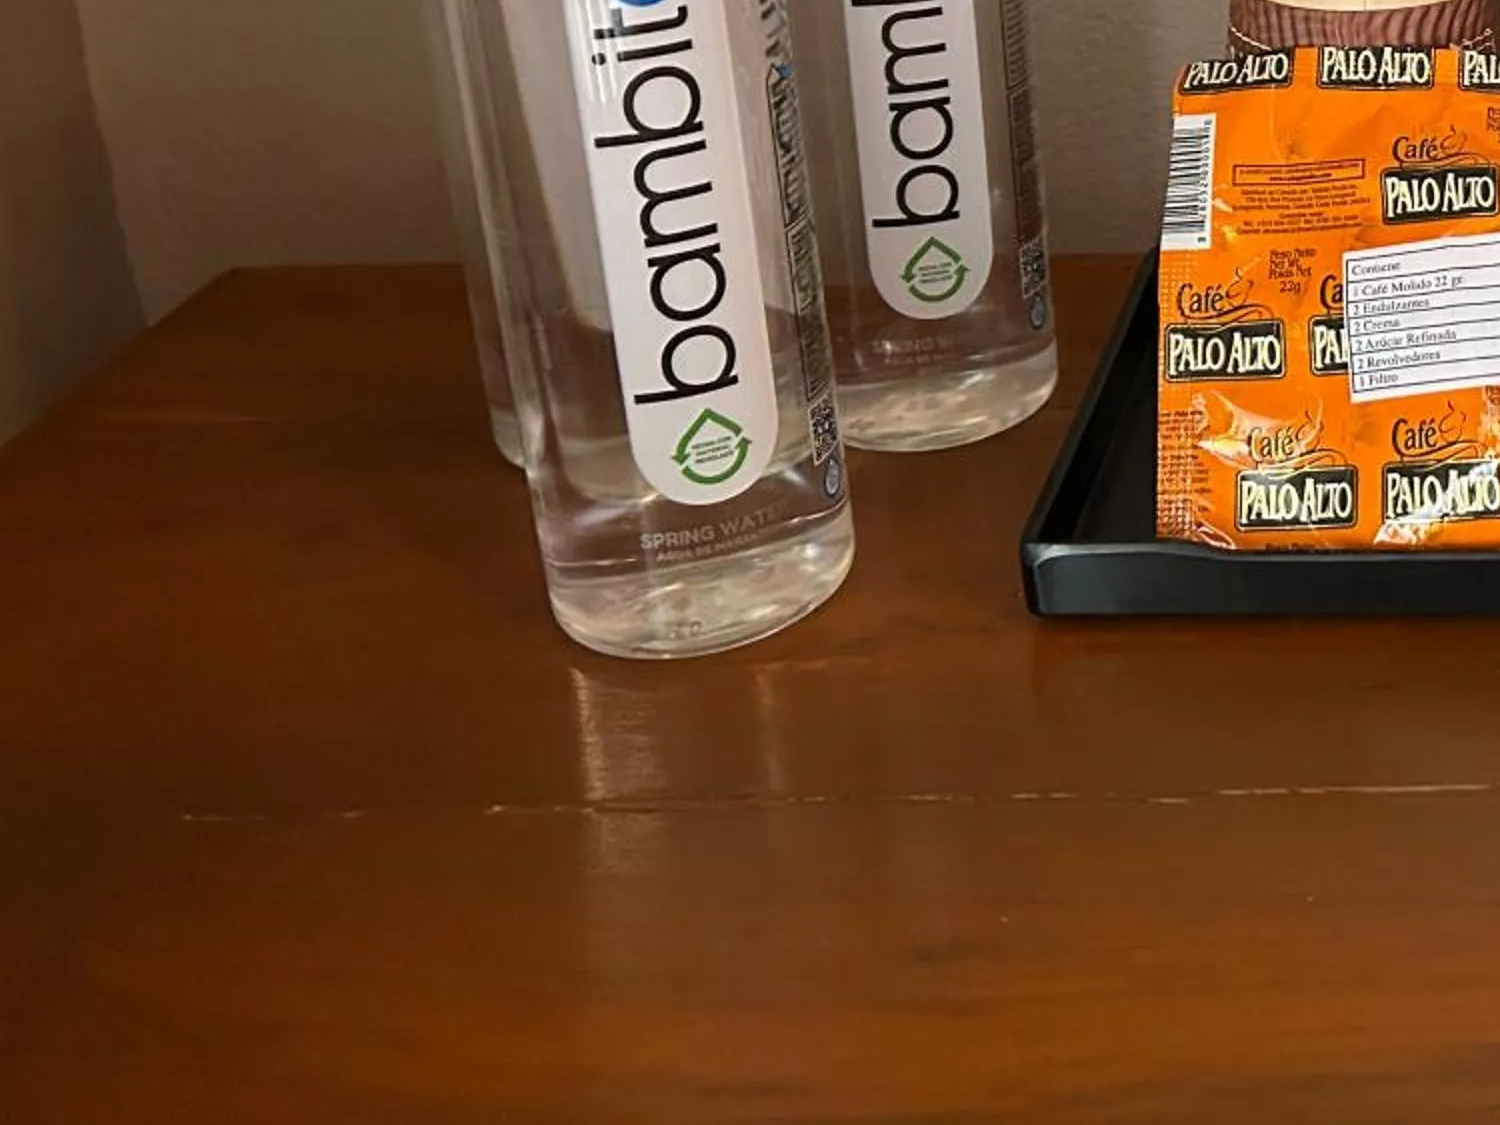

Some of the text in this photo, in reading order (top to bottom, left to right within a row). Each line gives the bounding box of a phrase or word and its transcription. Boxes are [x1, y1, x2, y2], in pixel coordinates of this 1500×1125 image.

[1183, 53, 1288, 87] PALO ALTO
[1322, 46, 1431, 84] PALO ALTO
[1392, 135, 1440, 163] Café
[1384, 174, 1439, 218] PALO
[1441, 168, 1495, 215] ALTO
[1351, 261, 1401, 275] Contiene
[1178, 282, 1226, 313] Café
[1320, 274, 1345, 310] Ca
[1361, 283, 1389, 296] Café
[1391, 277, 1433, 292] Molido
[1435, 275, 1448, 287] 22
[1363, 300, 1431, 314] Endulzantes
[1363, 318, 1401, 330] Crema
[1169, 328, 1282, 376] PALO ALTO
[1367, 352, 1441, 369] Revolvedores
[1368, 373, 1400, 386] Filtro
[1248, 426, 1295, 462] Café
[1392, 418, 1438, 453] Café
[1239, 474, 1352, 523] PALO ALTO
[1386, 472, 1441, 519] PALO
[1446, 467, 1500, 512] ALTO
[640, 525, 715, 550] SPRING
